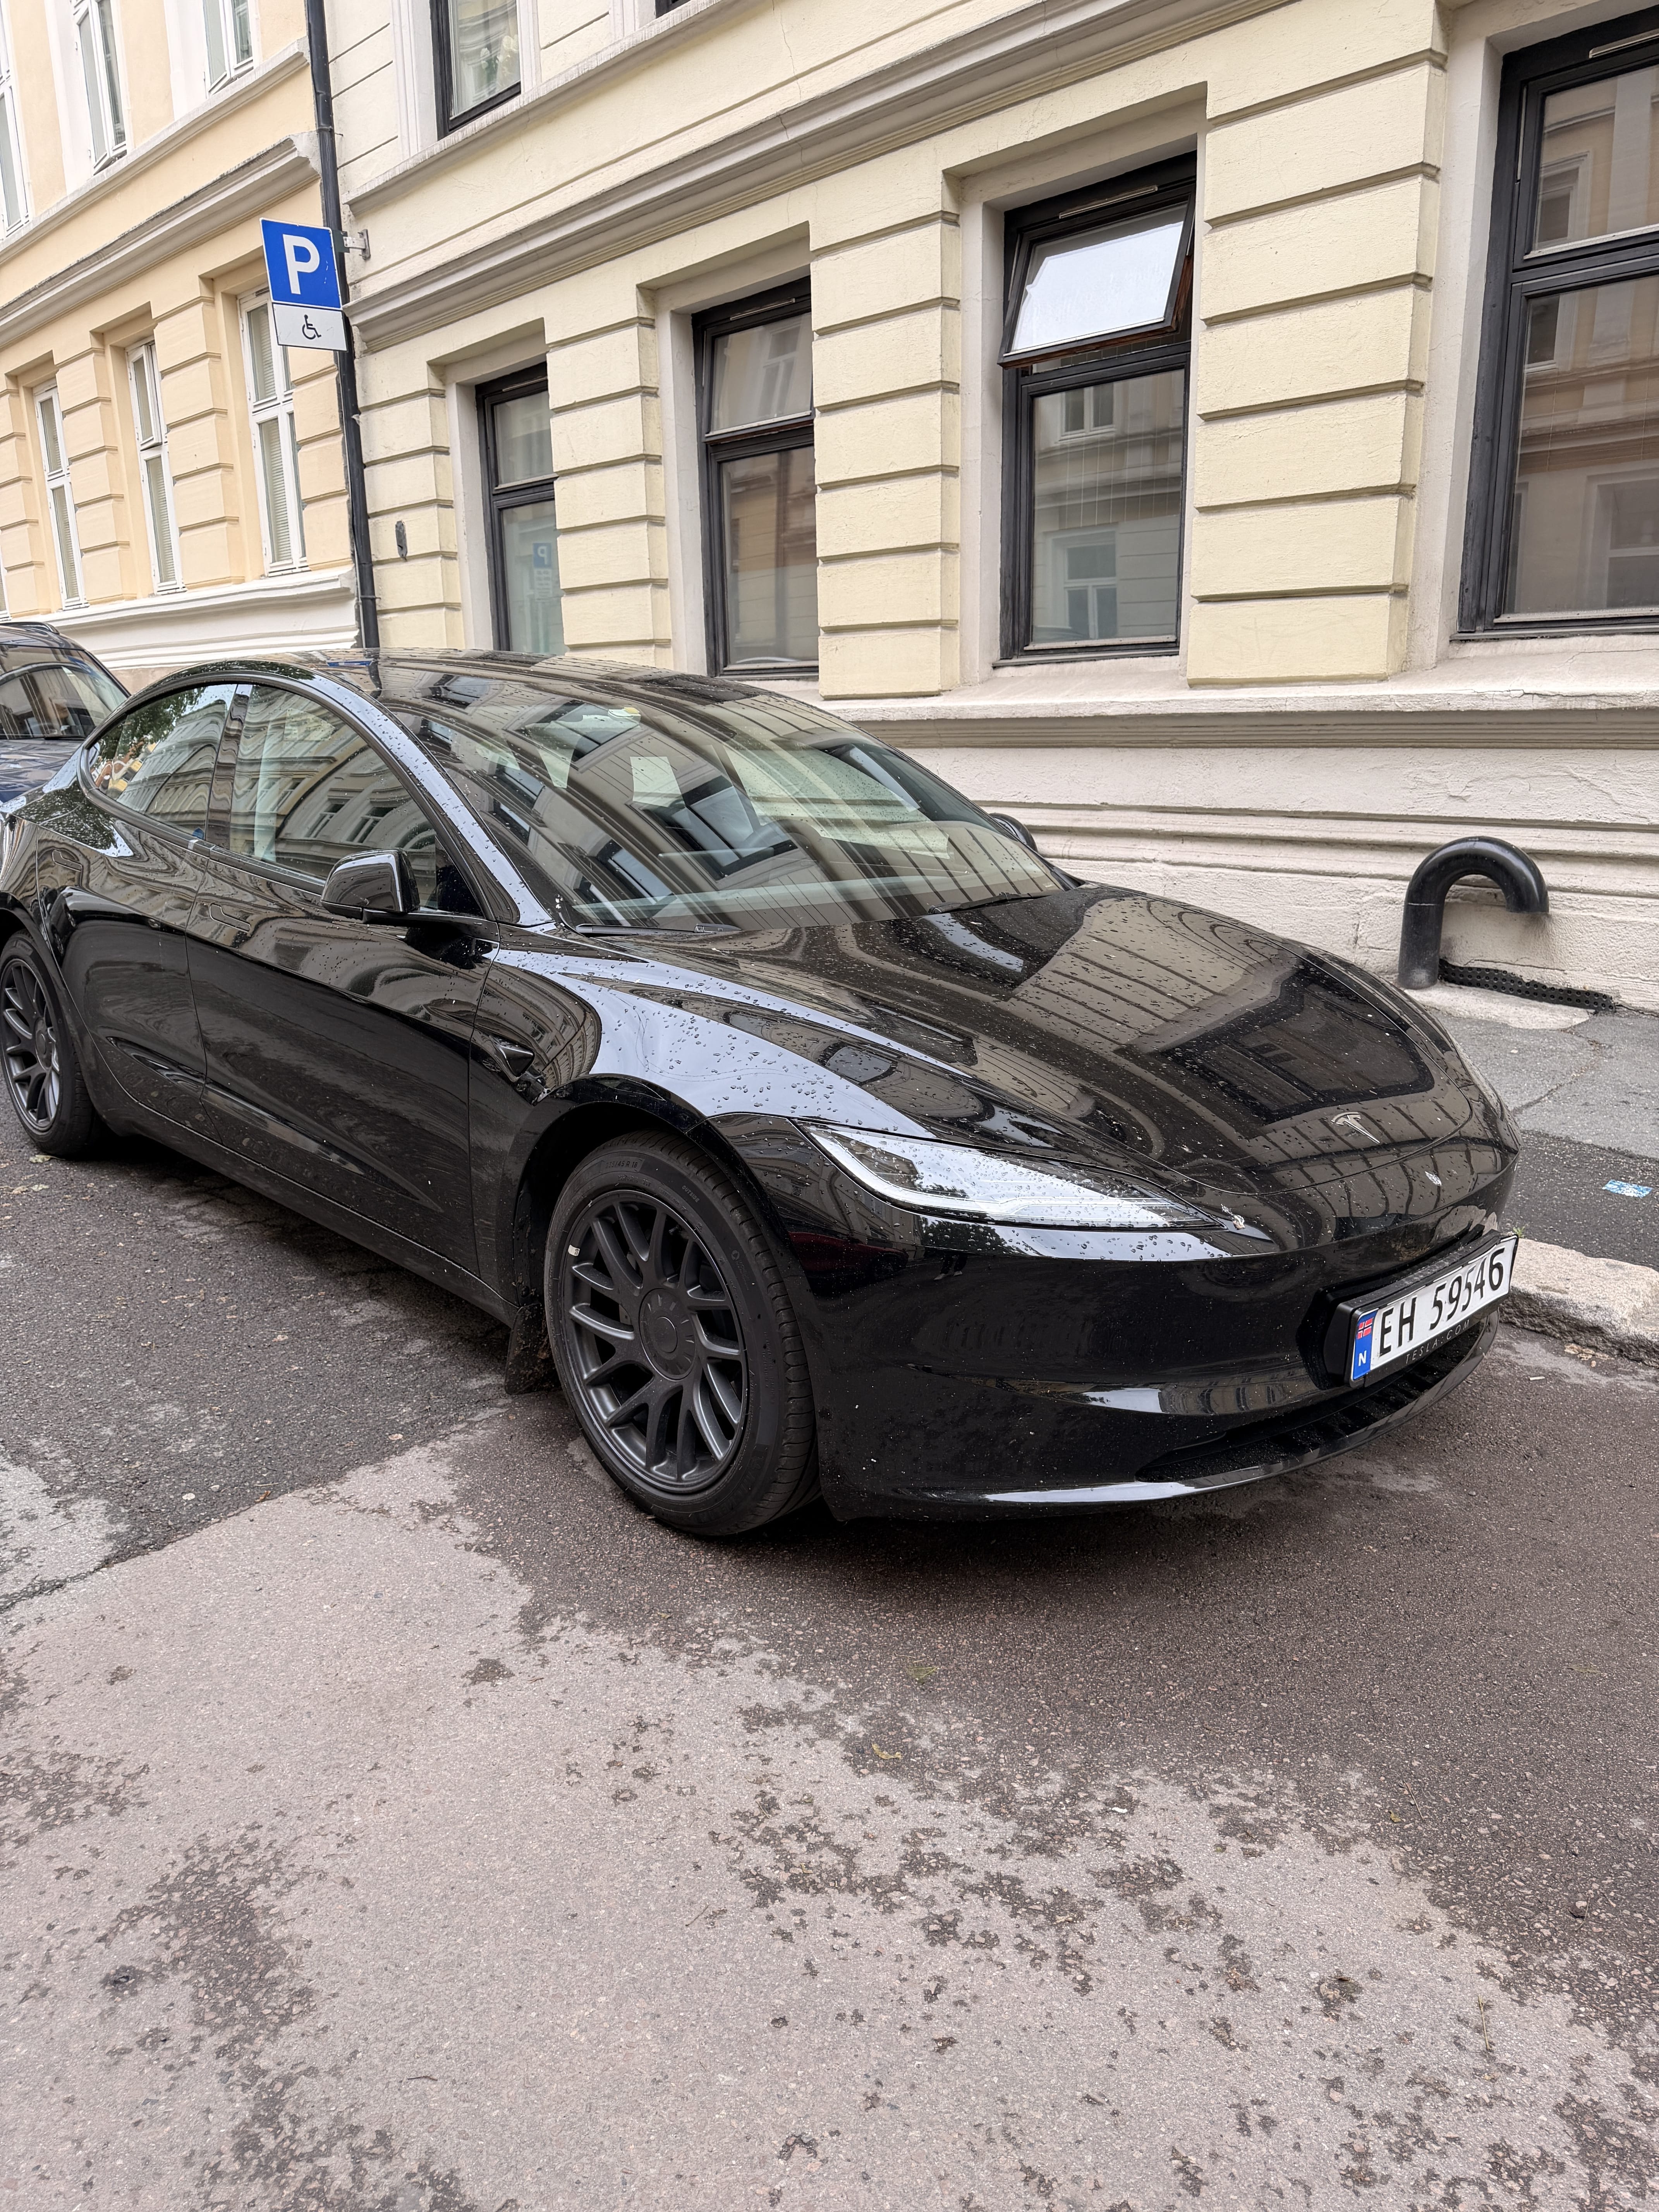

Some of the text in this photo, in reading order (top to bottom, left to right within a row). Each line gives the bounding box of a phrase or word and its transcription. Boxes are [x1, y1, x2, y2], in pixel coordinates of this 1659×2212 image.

[283, 234, 320, 295] P
[1379, 1248, 1506, 1357] EH 59546
[1358, 1350, 1367, 1367] N
